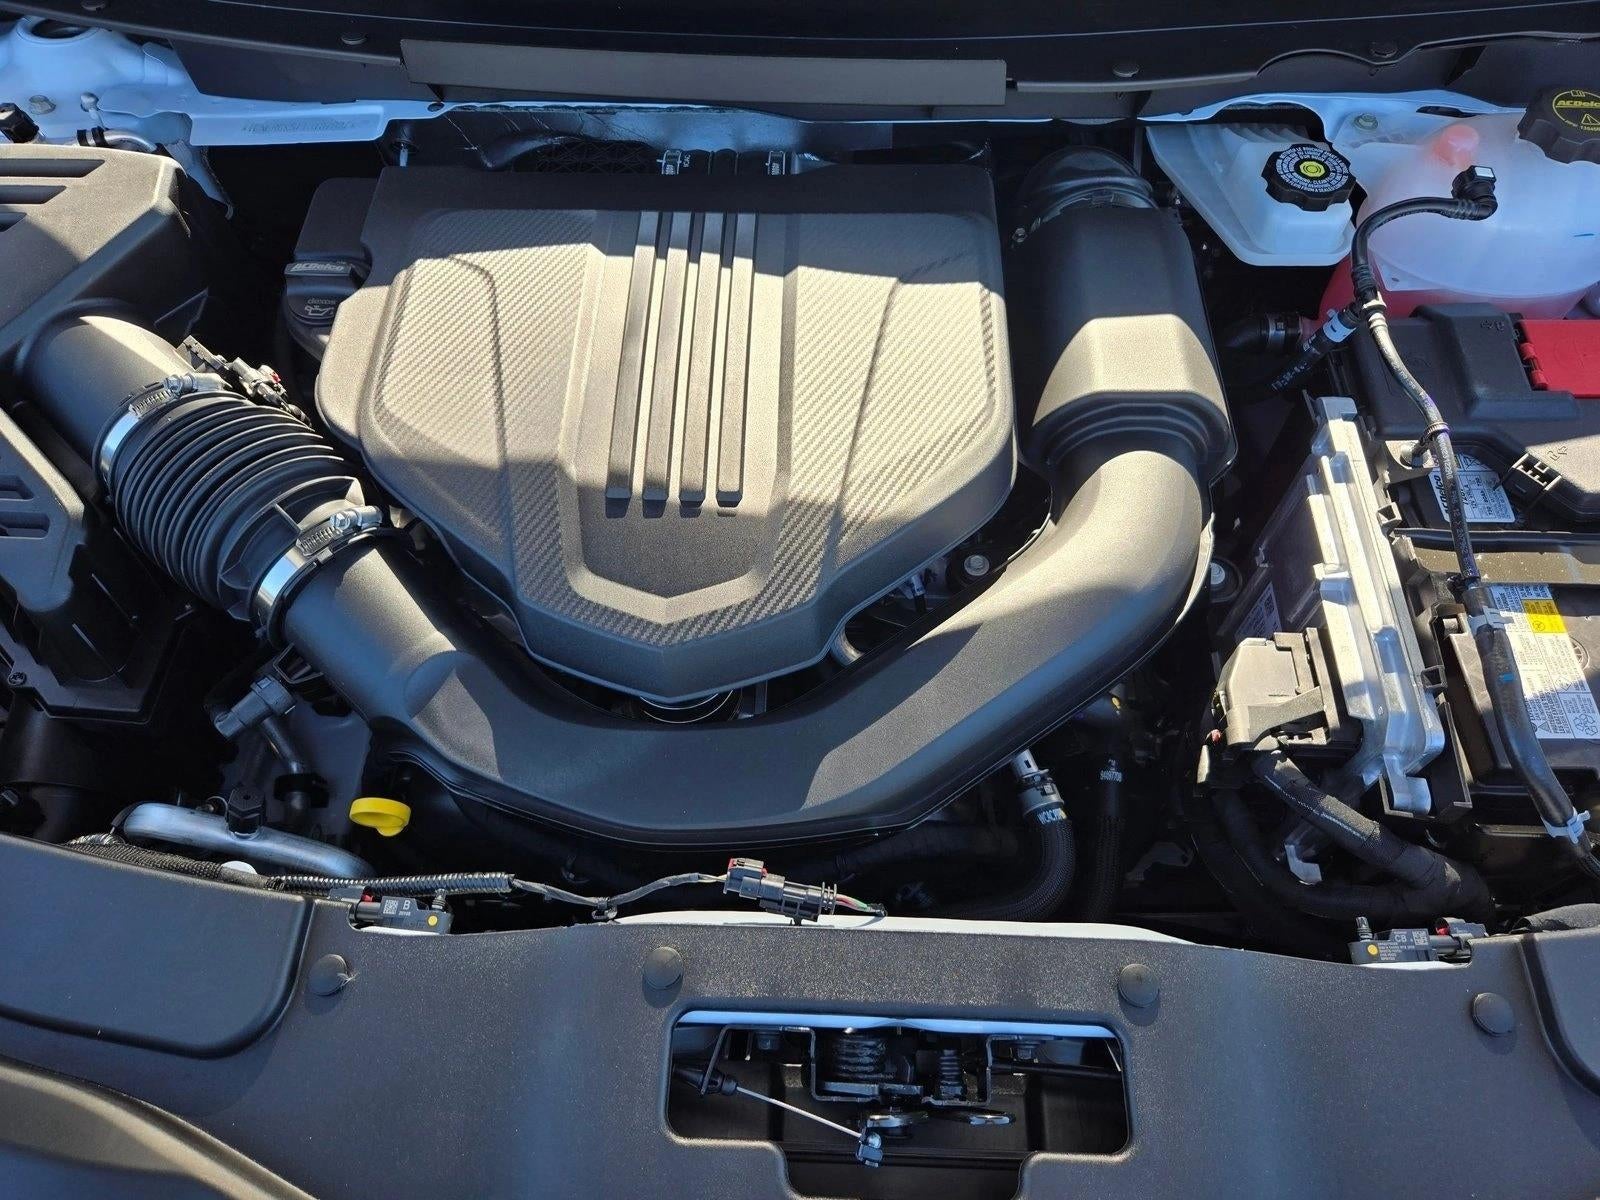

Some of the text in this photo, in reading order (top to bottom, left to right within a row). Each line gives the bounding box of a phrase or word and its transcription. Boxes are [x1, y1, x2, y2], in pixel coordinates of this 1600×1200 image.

[290, 263, 344, 272] ACDelco
[403, 900, 411, 910] B
[1395, 934, 1407, 943] CB
